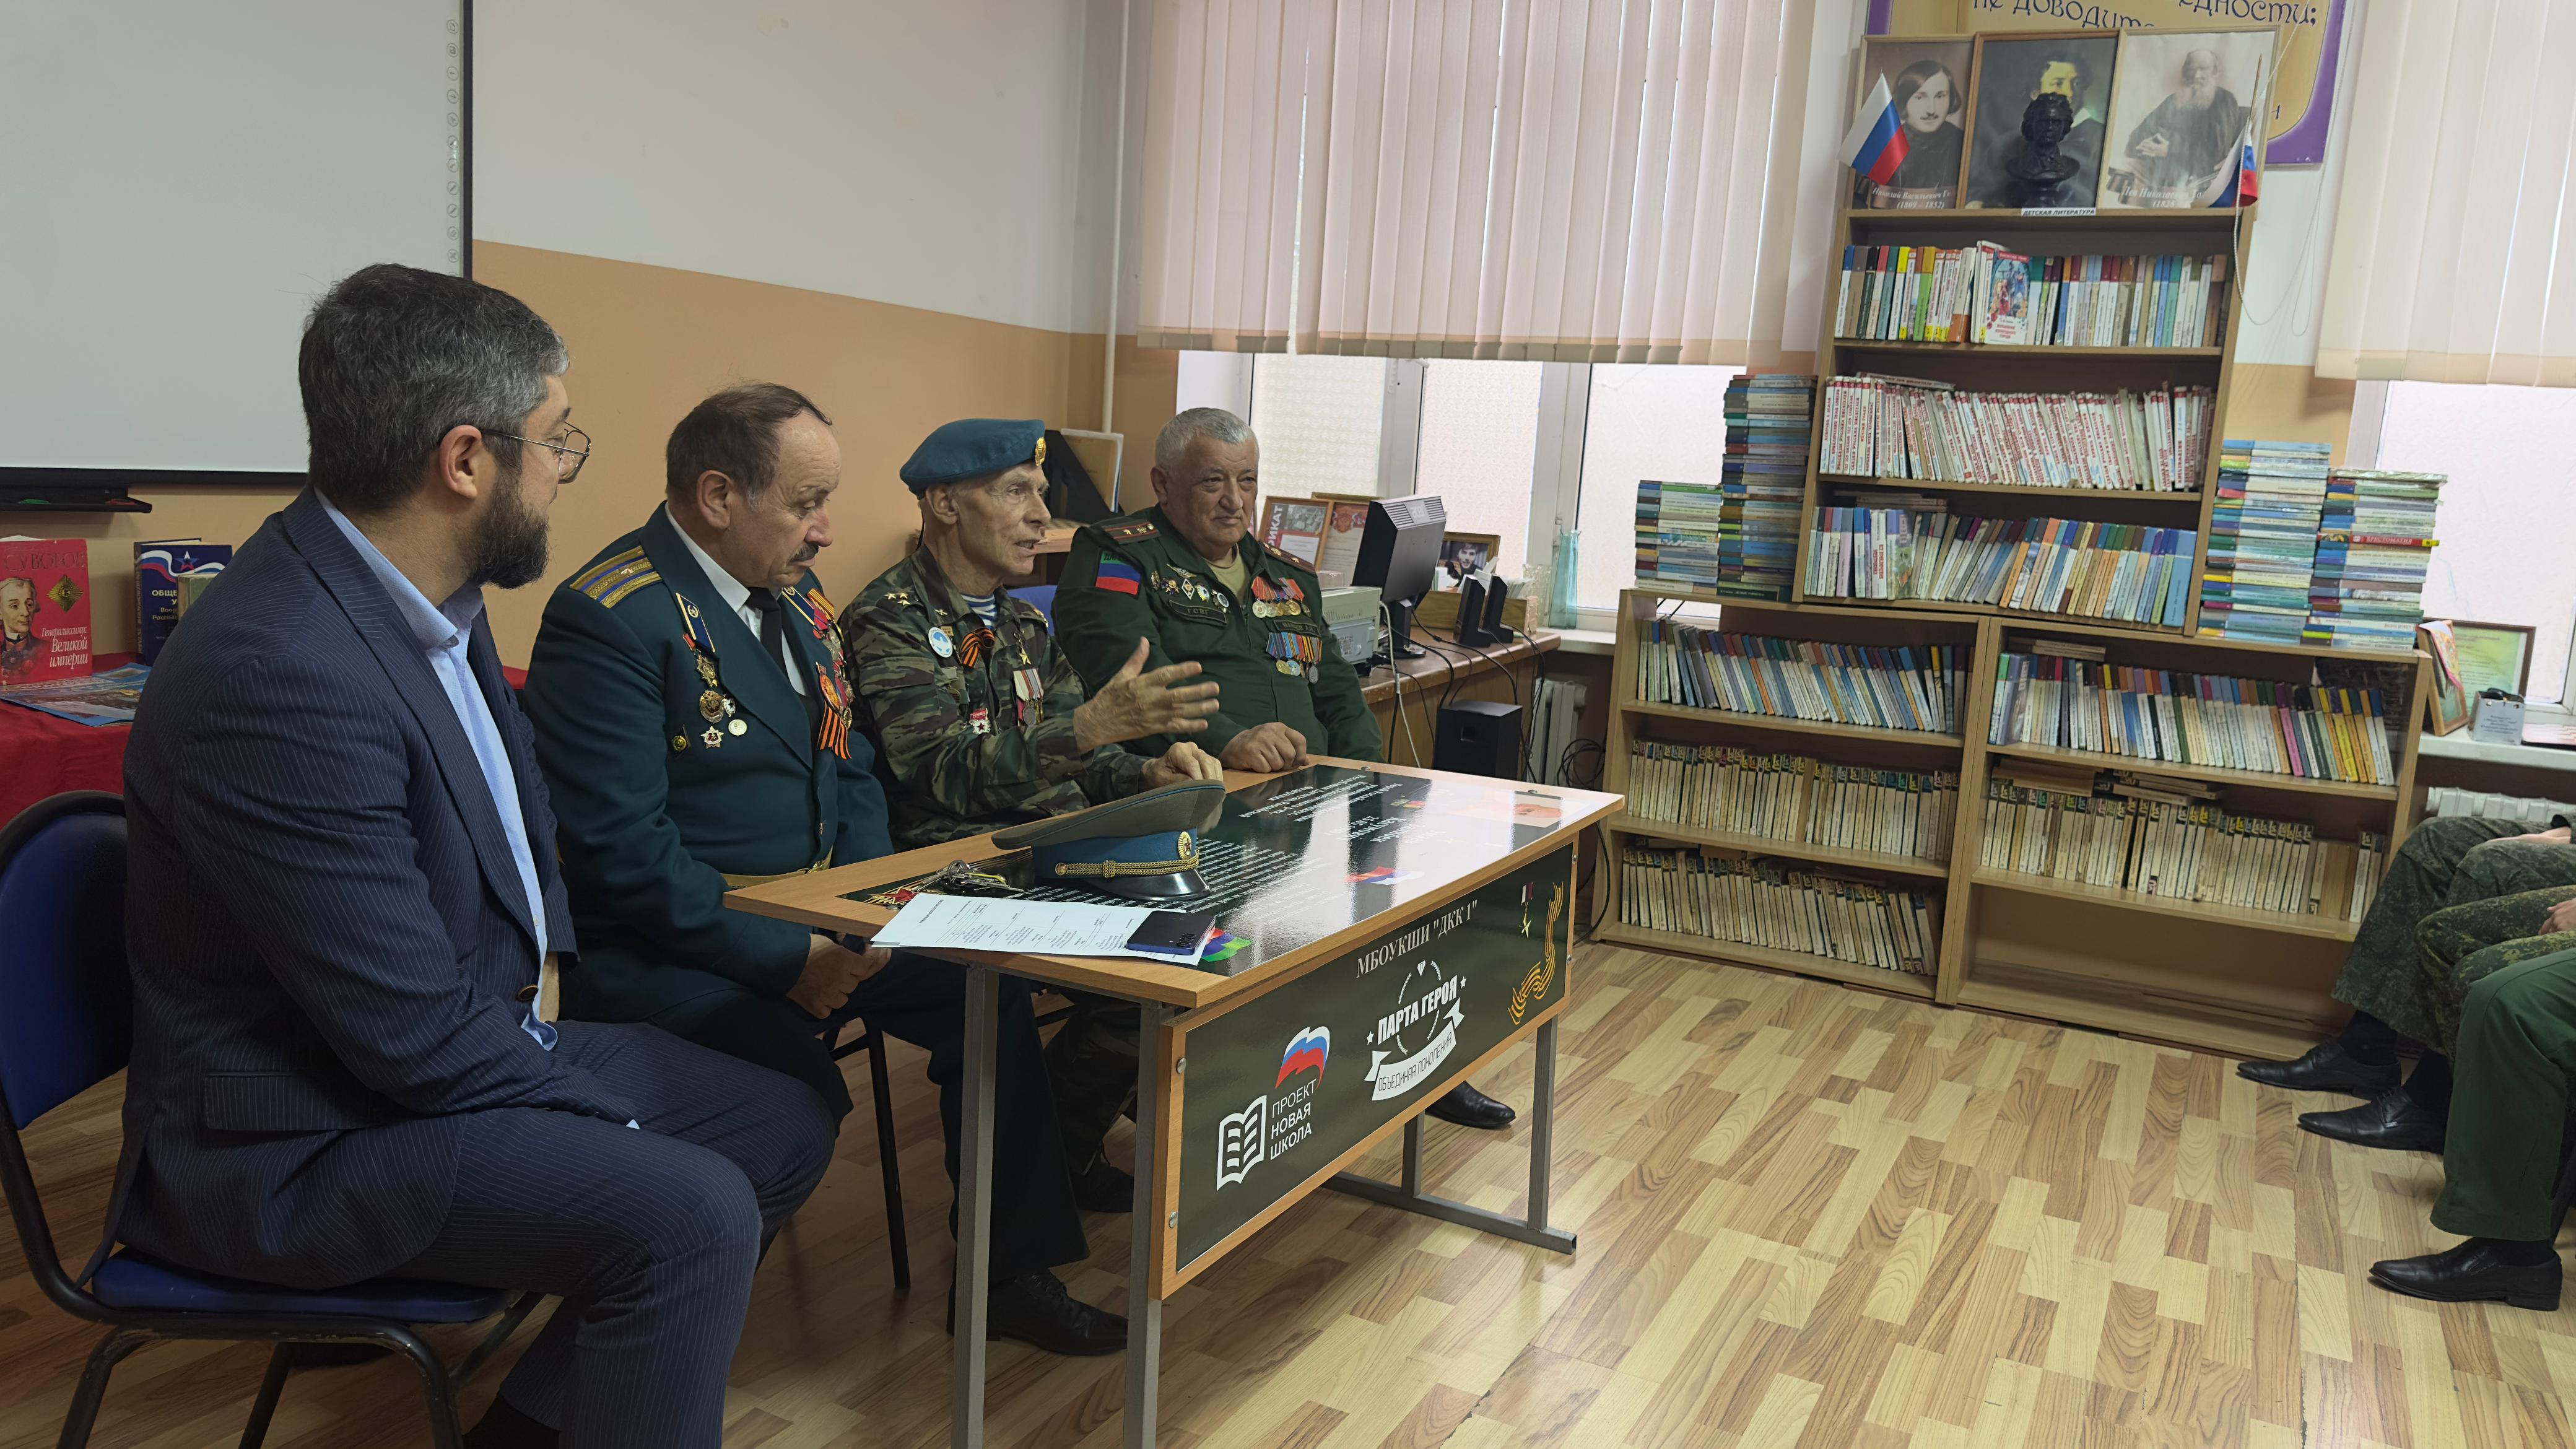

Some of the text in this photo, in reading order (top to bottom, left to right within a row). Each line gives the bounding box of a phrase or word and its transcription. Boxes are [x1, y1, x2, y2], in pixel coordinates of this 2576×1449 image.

[2139, 188, 2189, 199] Николае
[2366, 535, 2413, 545] ХРЕСТОМАТИЯ
[5, 552, 85, 572] СУВОРОВ
[41, 626, 87, 639] Генералиссимус
[51, 637, 87, 653] Великой
[50, 653, 88, 669] империи
[1356, 900, 1477, 978] МБОУКШИ "ДКК 1"
[1377, 974, 1458, 1046] ПАРТА ГЕРОЯ
[1377, 1032, 1453, 1092] ОБЪЕДИНЯЯ ПОКОЛЕНИЯ
[1271, 1078, 1317, 1119] ПРОЕКТ
[1271, 1102, 1312, 1140] НОВАЯ
[1269, 1124, 1312, 1160] ШКОЛА
